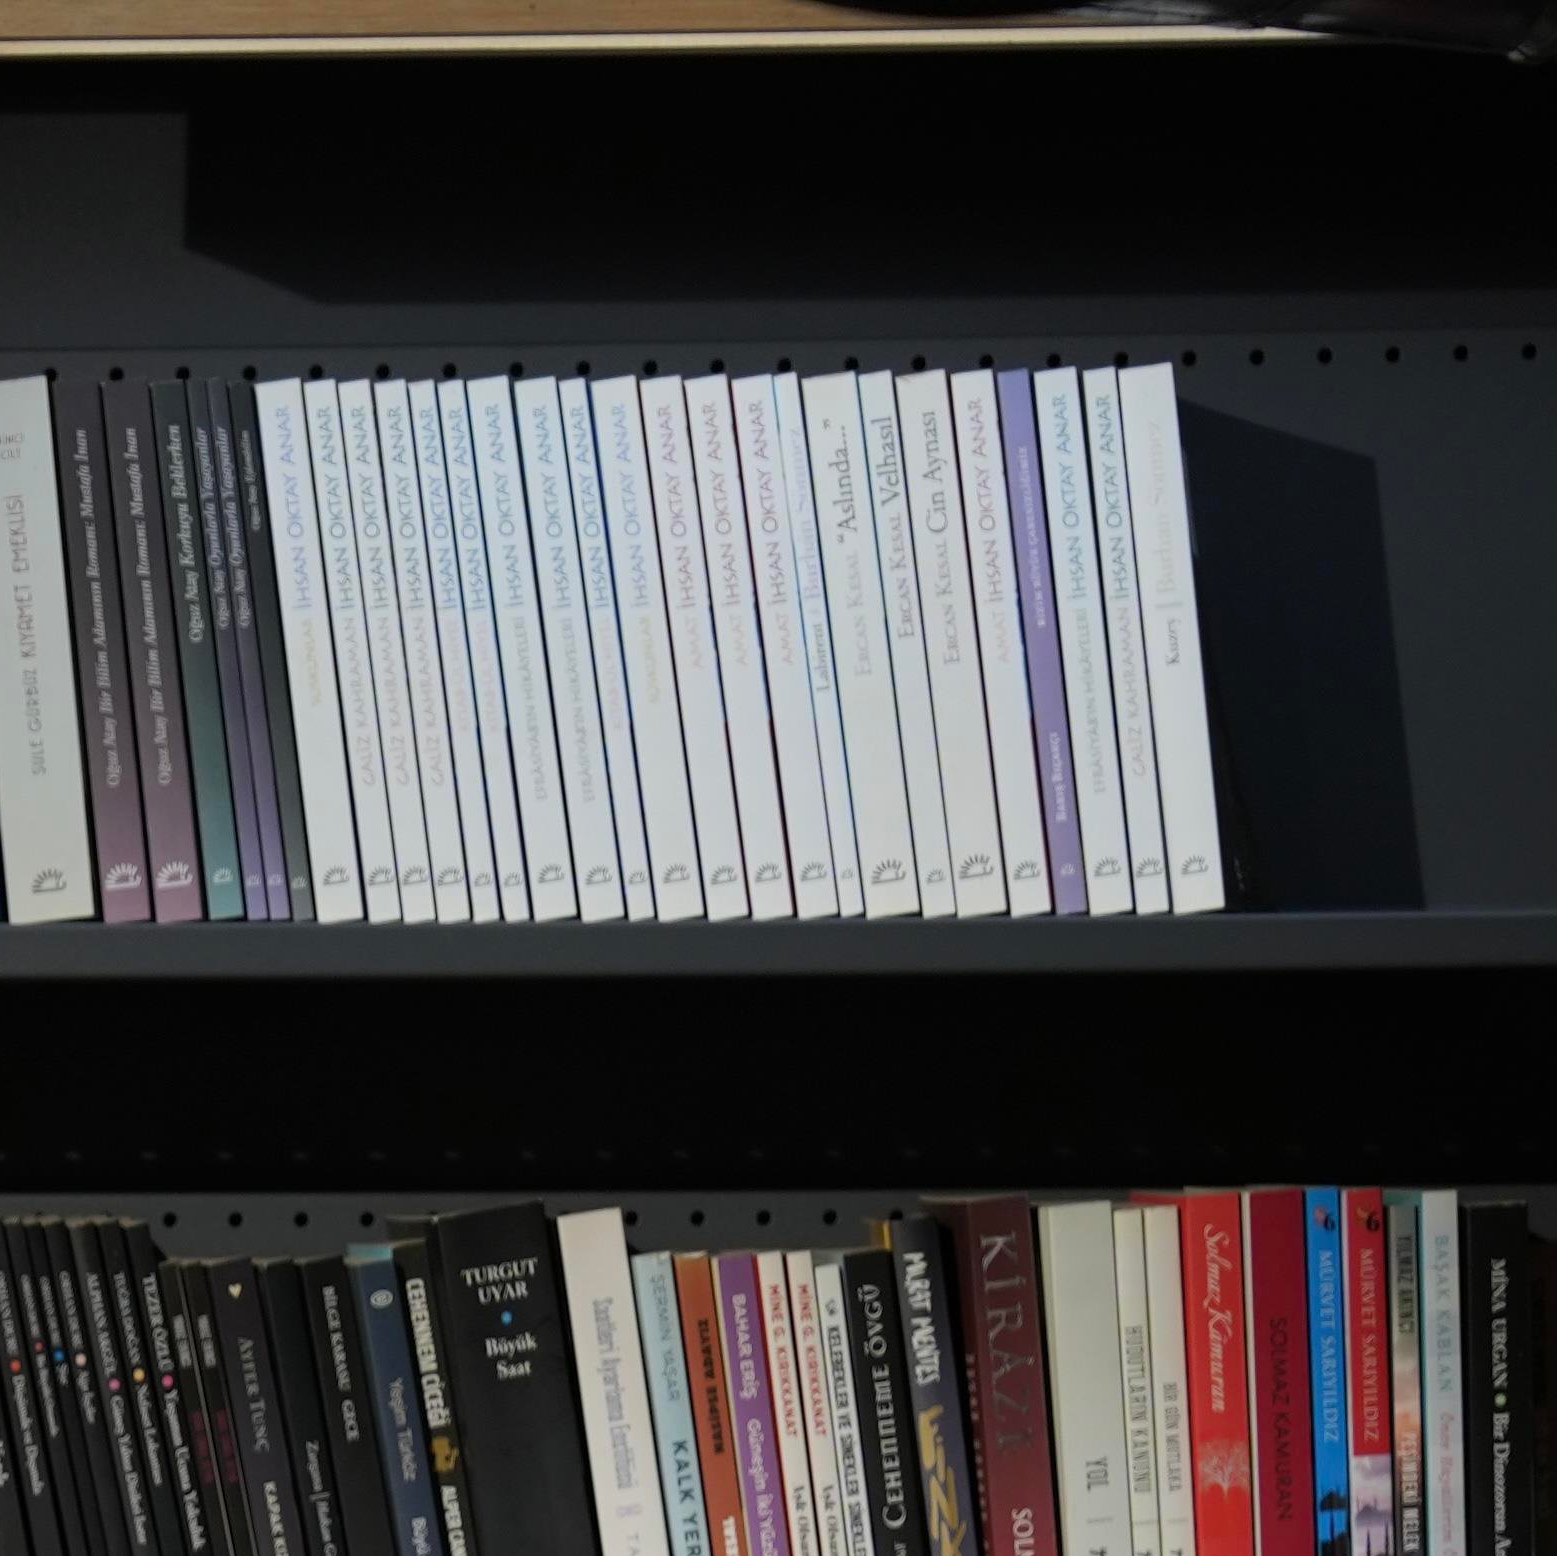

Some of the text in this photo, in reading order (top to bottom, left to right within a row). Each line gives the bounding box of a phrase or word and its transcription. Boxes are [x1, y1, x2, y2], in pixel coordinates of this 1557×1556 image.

[1052, 395, 1070, 453] ANAR
[1059, 461, 1079, 527] OKTAY
[459, 1257, 539, 1287] TURGUT
[477, 1280, 529, 1306] UYAR
[1201, 1224, 1229, 1309] Solmaz
[1489, 1260, 1509, 1312] MİNA
[730, 1294, 754, 1357] BAHAR
[1358, 1248, 1382, 1441] MÜRVET SARIYILDIZ
[1491, 1318, 1508, 1388] URGAN
[1491, 1412, 1508, 1441] Bir
[672, 1440, 696, 1505] KALK
